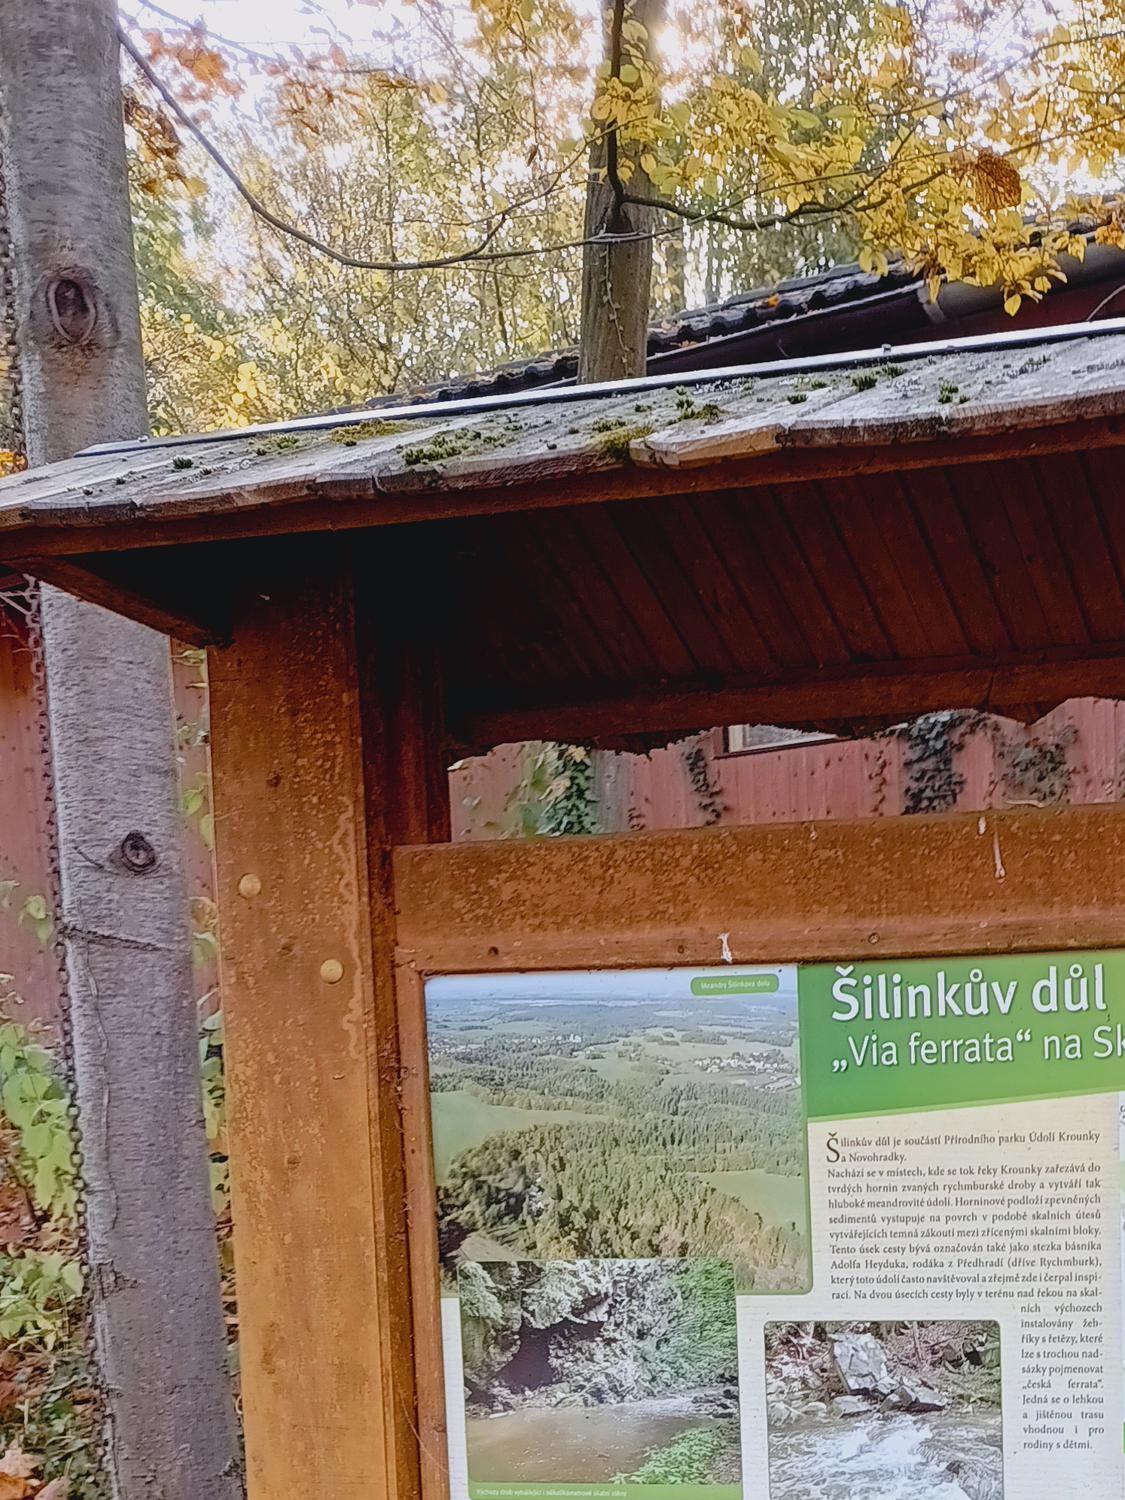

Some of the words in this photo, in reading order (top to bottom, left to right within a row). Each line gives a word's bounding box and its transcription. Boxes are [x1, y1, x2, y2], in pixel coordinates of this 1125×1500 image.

[831, 966, 1017, 1022] Šilinkův
[1031, 964, 1107, 1013] důl
[831, 1035, 899, 1072] „Via
[909, 1030, 1032, 1066] ferrata“
[1043, 1035, 1081, 1061] na
[875, 1136, 890, 1146] důl
[893, 1137, 901, 1148] je
[904, 1135, 941, 1145] součástí
[998, 1132, 1025, 1146] parku
[1028, 1131, 1055, 1142] Údolí
[1058, 1130, 1100, 1144] Krounky
[827, 1167, 864, 1178] Nachází
[927, 1165, 944, 1176] kde
[947, 1168, 956, 1176] se
[959, 1165, 974, 1175] tok
[977, 1164, 998, 1178] řeky
[1000, 1163, 1042, 1177] Krounky
[1044, 1163, 1085, 1173] zařezává
[1087, 1162, 1101, 1172] do
[827, 1183, 862, 1197] tvrdých
[865, 1182, 897, 1192] hornin
[901, 1181, 939, 1194] zvaných
[1007, 1179, 1036, 1192] droby
[1048, 1178, 1081, 1192] vytváří
[1085, 1177, 1101, 1188] tak
[828, 1213, 876, 1224] sedimentů
[880, 1214, 925, 1226] vystupuje
[944, 1211, 977, 1225] povrch
[991, 1210, 1027, 1224] podobě
[1031, 1209, 1071, 1220] skalních
[1075, 1209, 1101, 1219] útesů
[889, 1228, 918, 1238] temná
[920, 1227, 954, 1237] zákoutí
[956, 1228, 979, 1237] mezi
[980, 1226, 1027, 1239] zřícenými
[1029, 1225, 1070, 1236] skalními
[830, 1259, 861, 1269] Adolfa
[912, 1258, 944, 1268] rodáka
[957, 1257, 1003, 1268] Předhradí
[1007, 1257, 1035, 1268] (dříve
[1020, 1303, 1040, 1313] ních
[1054, 1302, 1102, 1315] výchozech
[1021, 1364, 1047, 1376] sázky
[1021, 1379, 1051, 1389] „česká
[1022, 1394, 1048, 1405] Jedná
[1051, 1396, 1060, 1404] se
[1072, 1393, 1104, 1404] lehkou
[1023, 1439, 1054, 1451] rodiny
